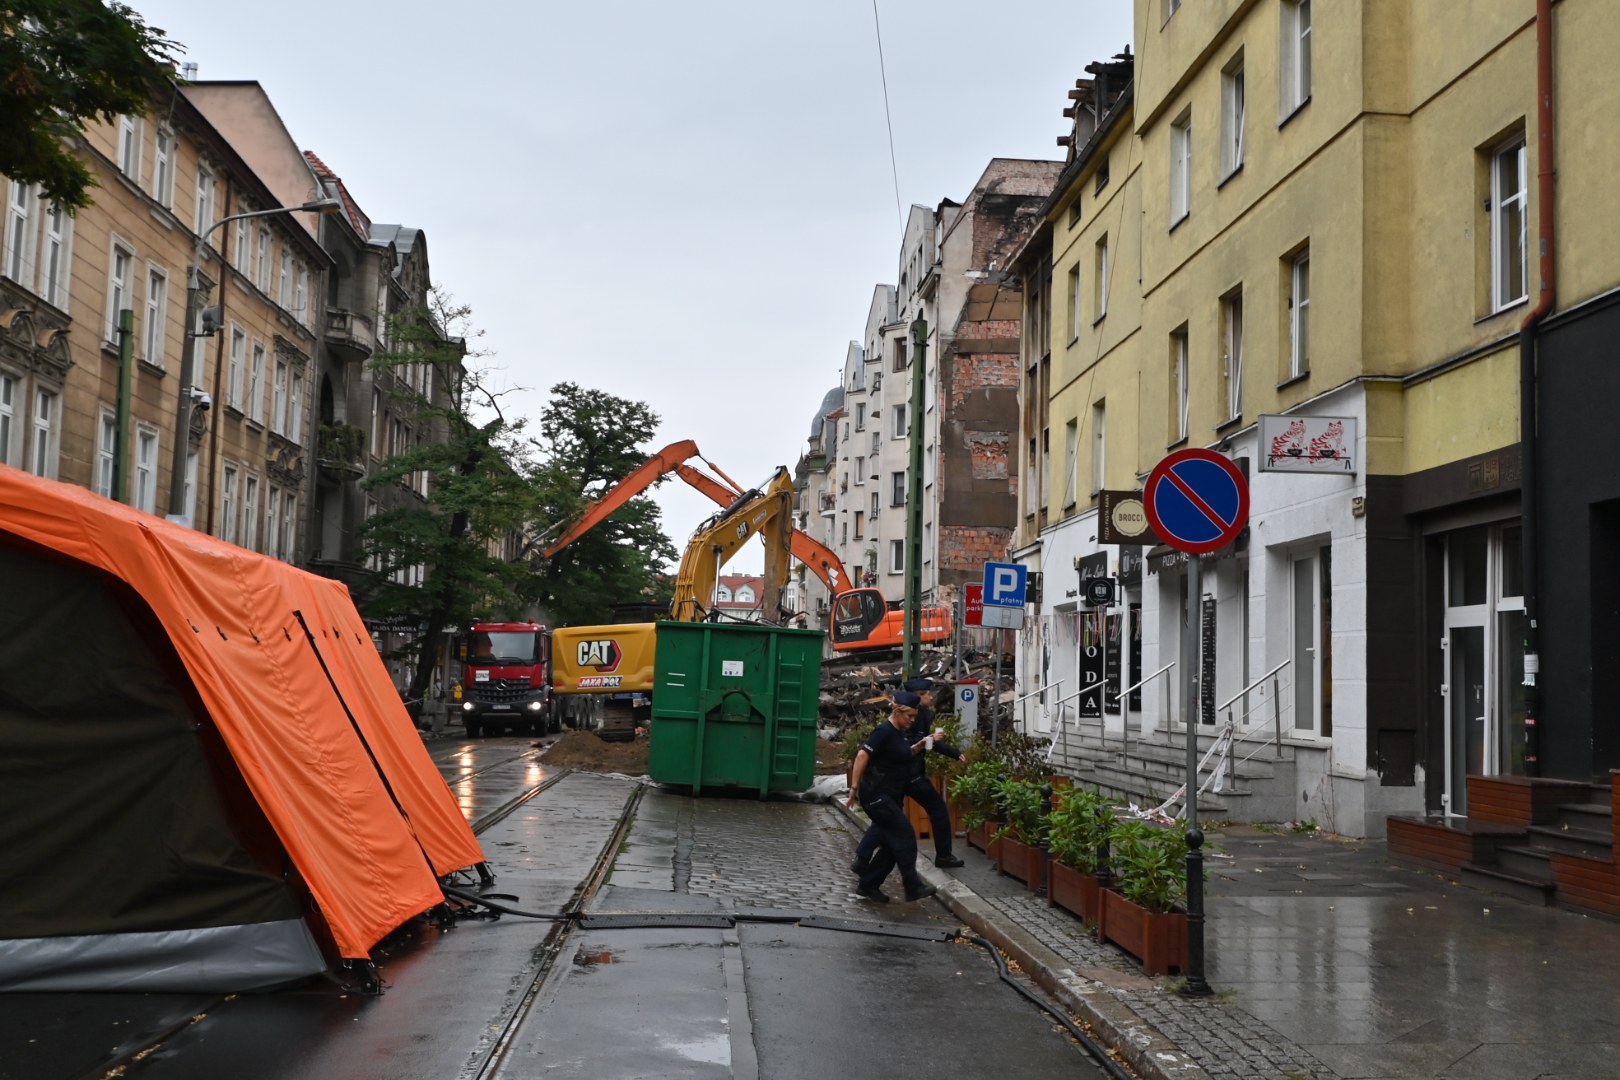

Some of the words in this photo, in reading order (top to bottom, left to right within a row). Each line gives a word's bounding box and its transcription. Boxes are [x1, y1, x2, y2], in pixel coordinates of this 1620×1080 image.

[1118, 513, 1143, 522] BROCCI
[1162, 554, 1176, 568] PIZZA
[1179, 551, 1190, 563] PAS
[992, 567, 1018, 601] P
[1000, 596, 1023, 606] płatny
[577, 640, 611, 666] CAT
